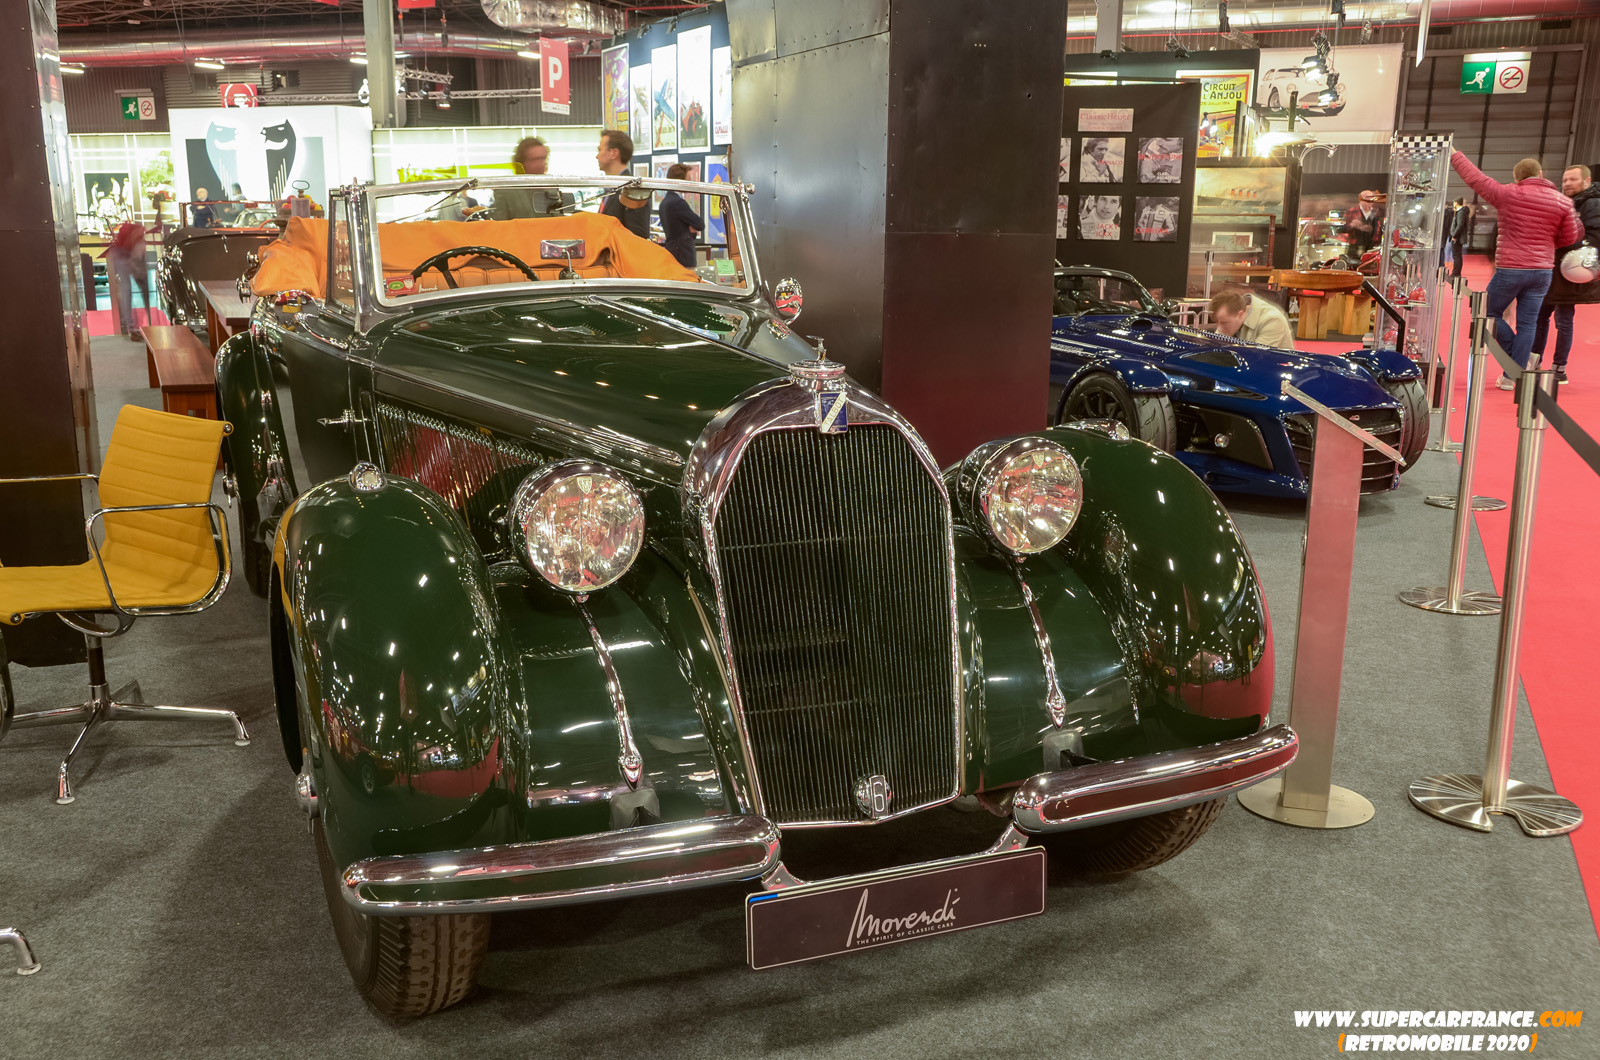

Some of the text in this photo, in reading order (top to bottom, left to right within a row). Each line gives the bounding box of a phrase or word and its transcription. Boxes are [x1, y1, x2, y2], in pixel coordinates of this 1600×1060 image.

[549, 56, 562, 88] P
[1203, 82, 1236, 92] CIRCUIT
[824, 399, 843, 425] TALBOT
[873, 781, 885, 812] 6
[846, 888, 960, 947] Movendi
[872, 934, 894, 943] SPIRIT
[908, 926, 935, 936] CLASSIC
[937, 922, 954, 930] CARS
